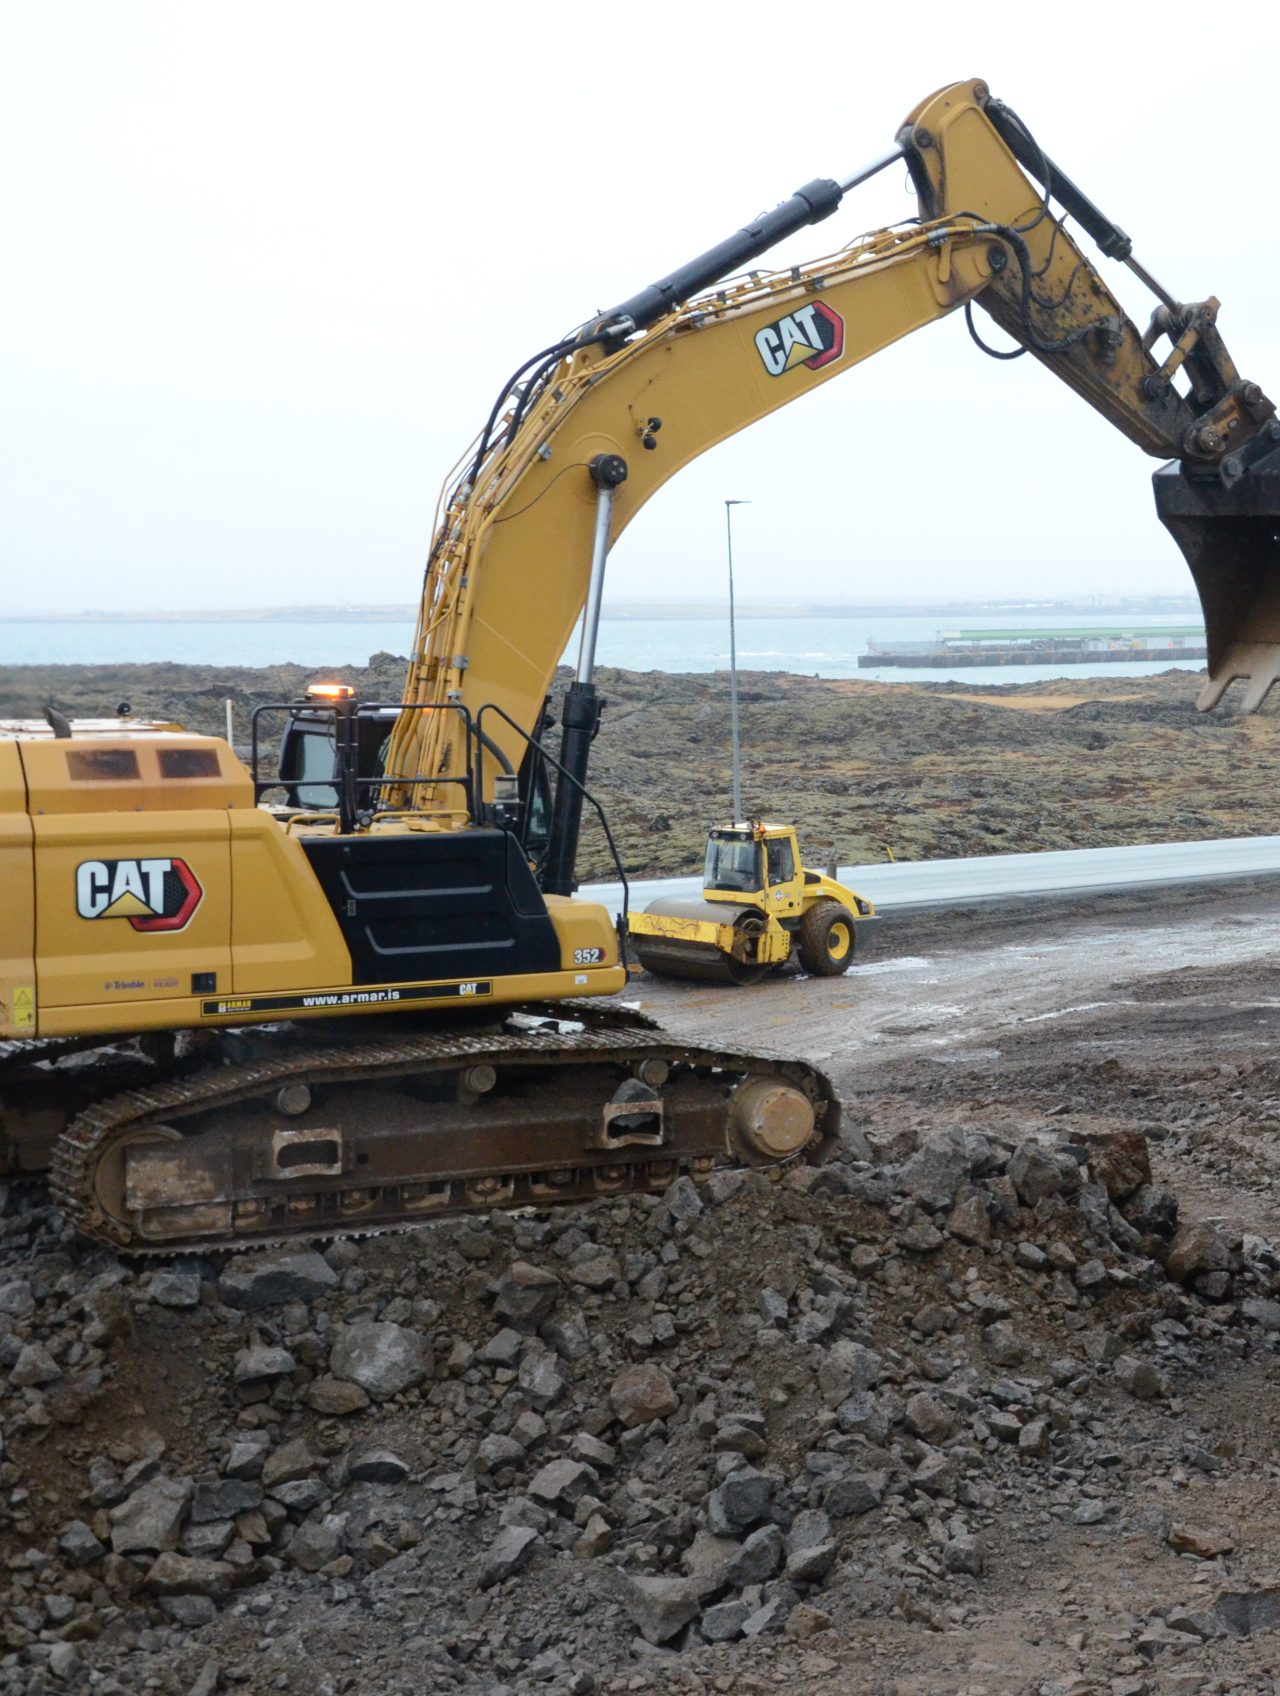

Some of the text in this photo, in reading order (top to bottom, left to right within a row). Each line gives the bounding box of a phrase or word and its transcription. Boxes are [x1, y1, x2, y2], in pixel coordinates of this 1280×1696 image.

[755, 304, 824, 375] CAT
[77, 859, 171, 918] CAT
[574, 948, 600, 964] 352
[303, 989, 400, 1006] www.armar.is
[459, 983, 477, 995] CAT
